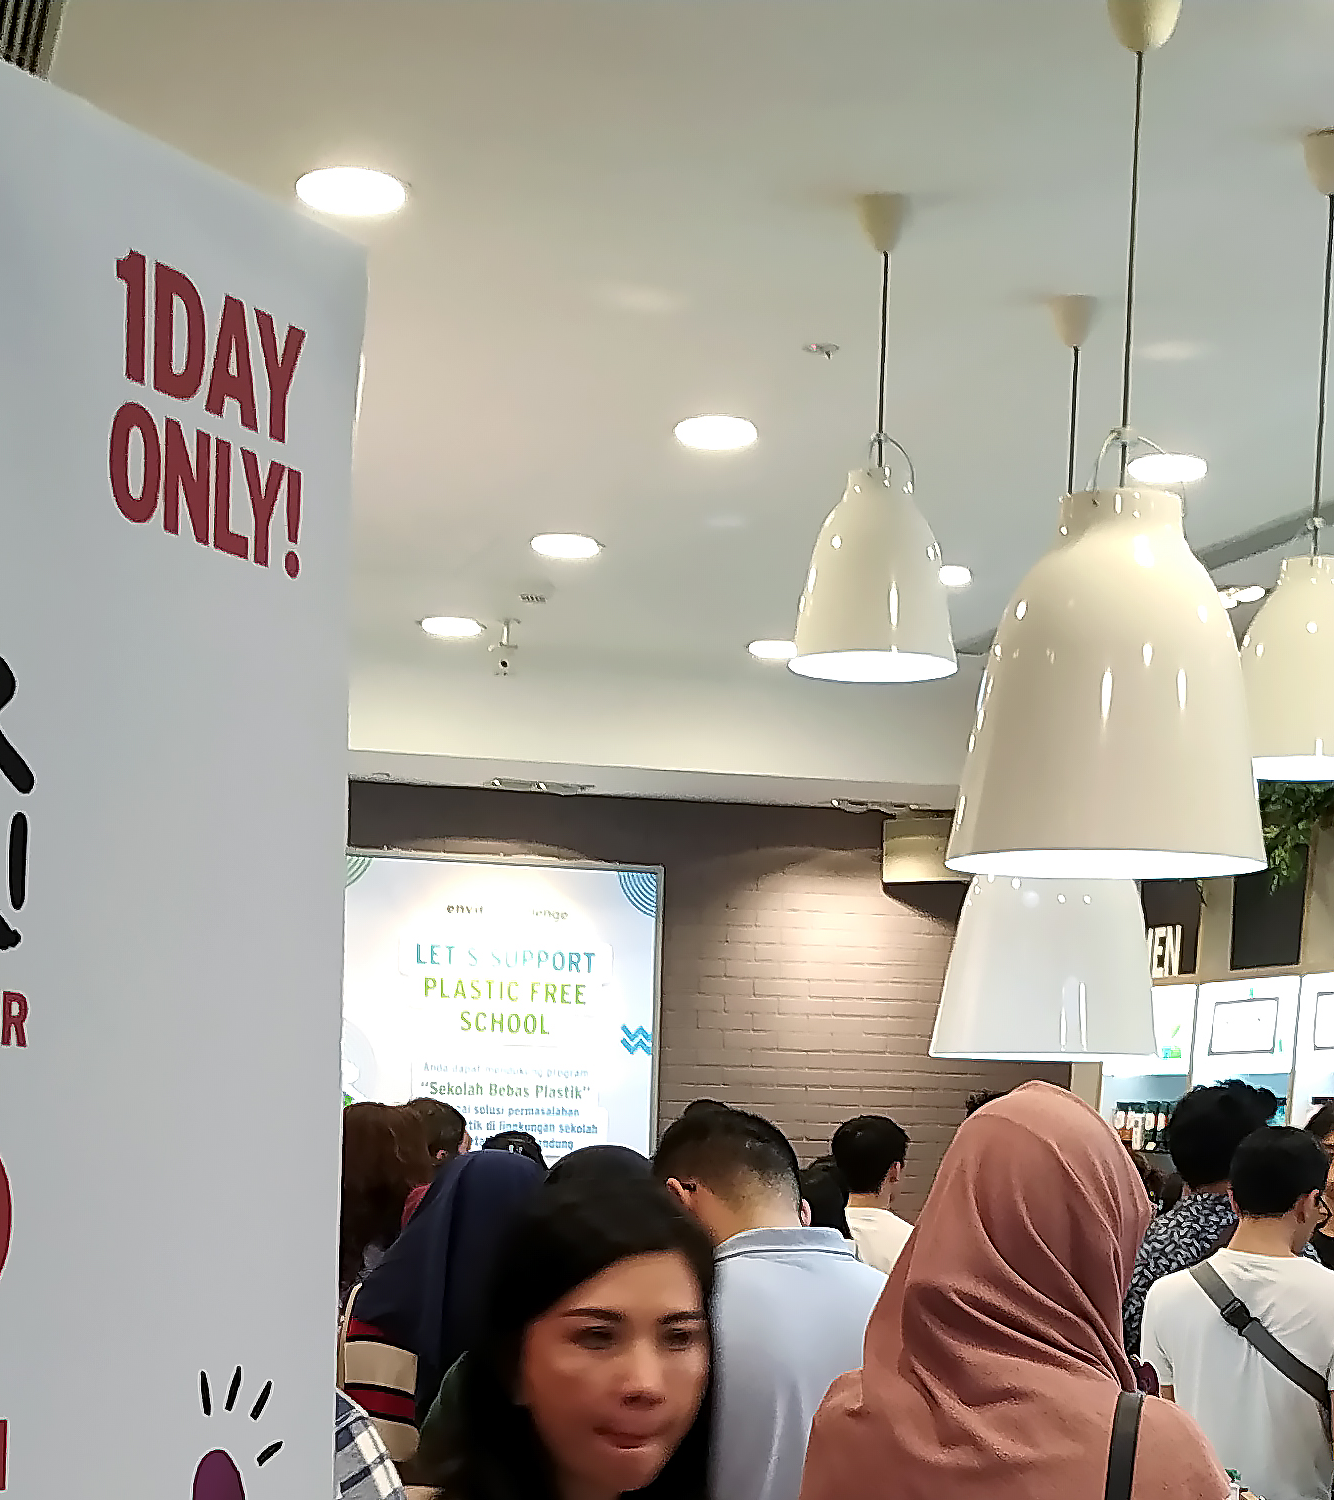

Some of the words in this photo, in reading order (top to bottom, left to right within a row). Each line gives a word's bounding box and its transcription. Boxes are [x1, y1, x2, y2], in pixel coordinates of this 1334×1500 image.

[116, 249, 307, 444] 1DAY
[109, 399, 303, 578] ONLY!
[417, 943, 479, 967] LETS
[491, 949, 596, 973] SUPPORT
[1147, 923, 1183, 978] EN
[424, 976, 520, 1002] PLASTIC
[531, 981, 587, 1005] FREE
[460, 1010, 550, 1035] SCHOOL
[489, 1083, 530, 1099] Bebas
